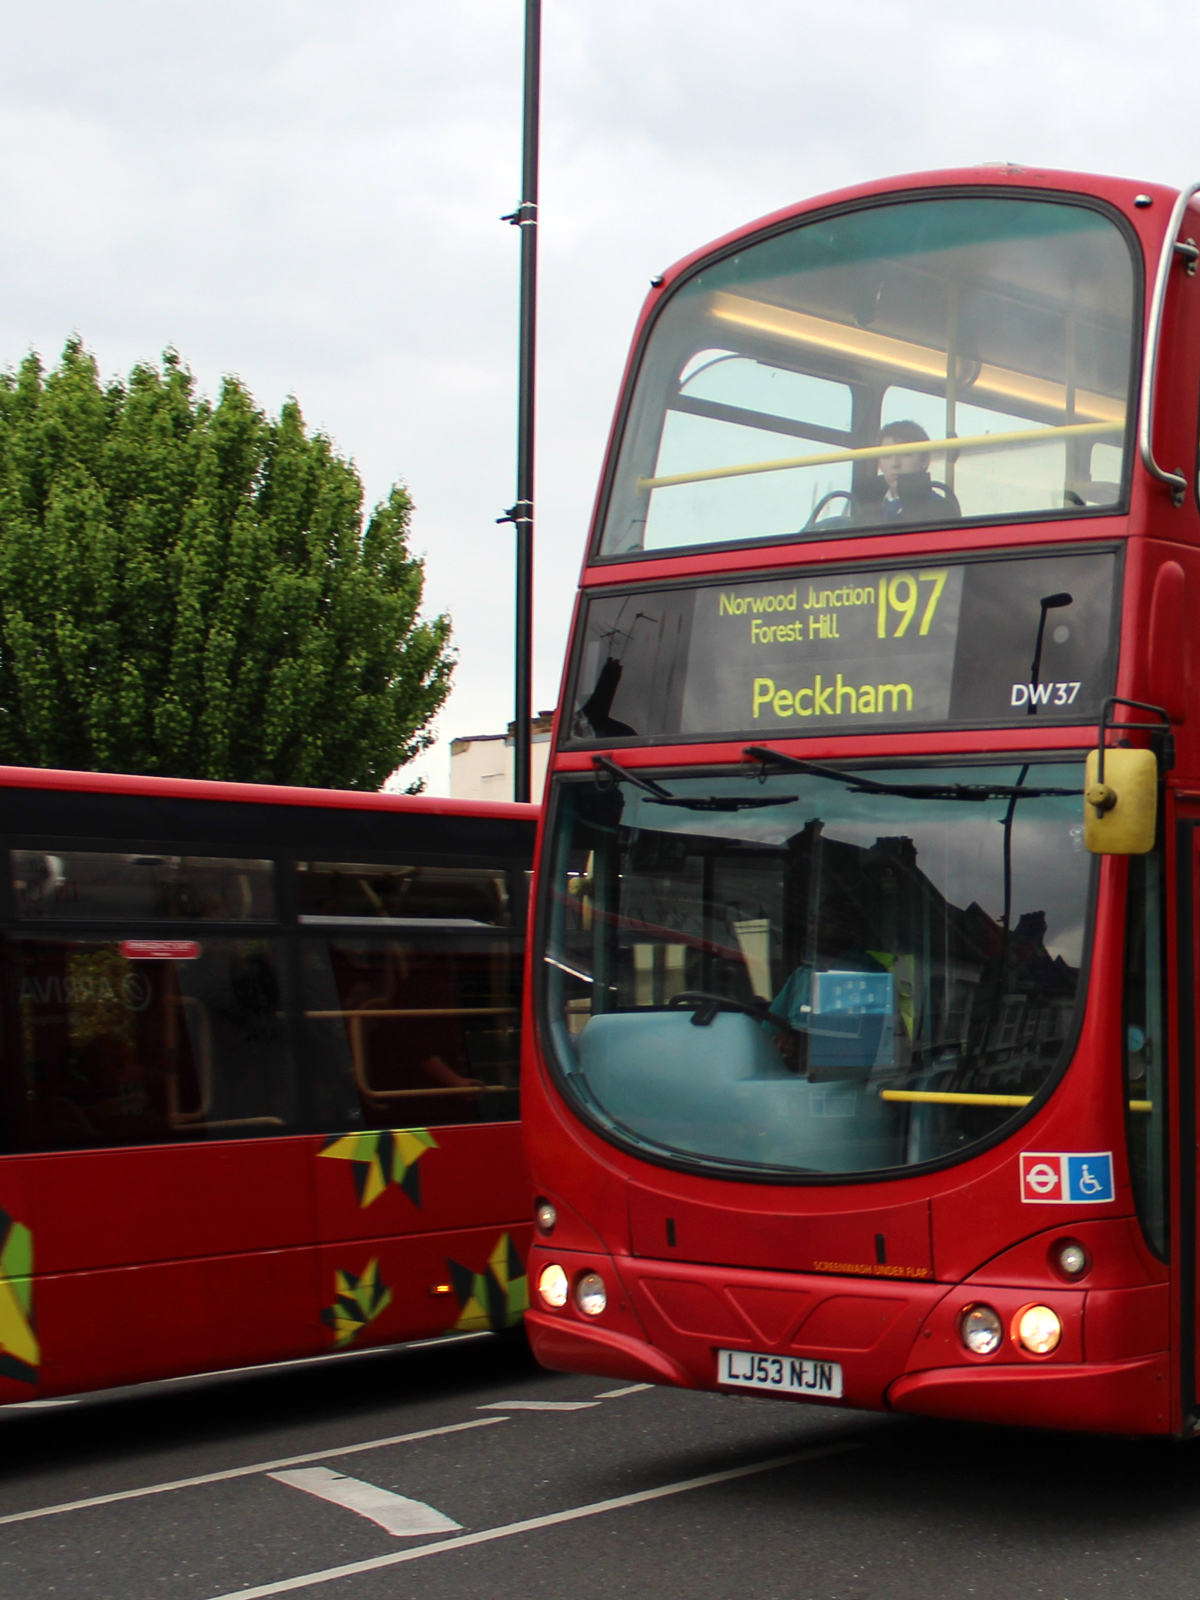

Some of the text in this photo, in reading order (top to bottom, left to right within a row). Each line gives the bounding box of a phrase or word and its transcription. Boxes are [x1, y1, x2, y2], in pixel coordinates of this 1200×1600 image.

[718, 584, 875, 616] Norwood Junction
[877, 570, 948, 638] 197
[751, 613, 840, 644] Forest Hill
[752, 673, 914, 718] Peckham
[1011, 682, 1082, 706] DW37
[813, 1261, 928, 1277] SCREENWASH UNDER FLAP
[728, 1353, 832, 1391] LJ53 NJN
